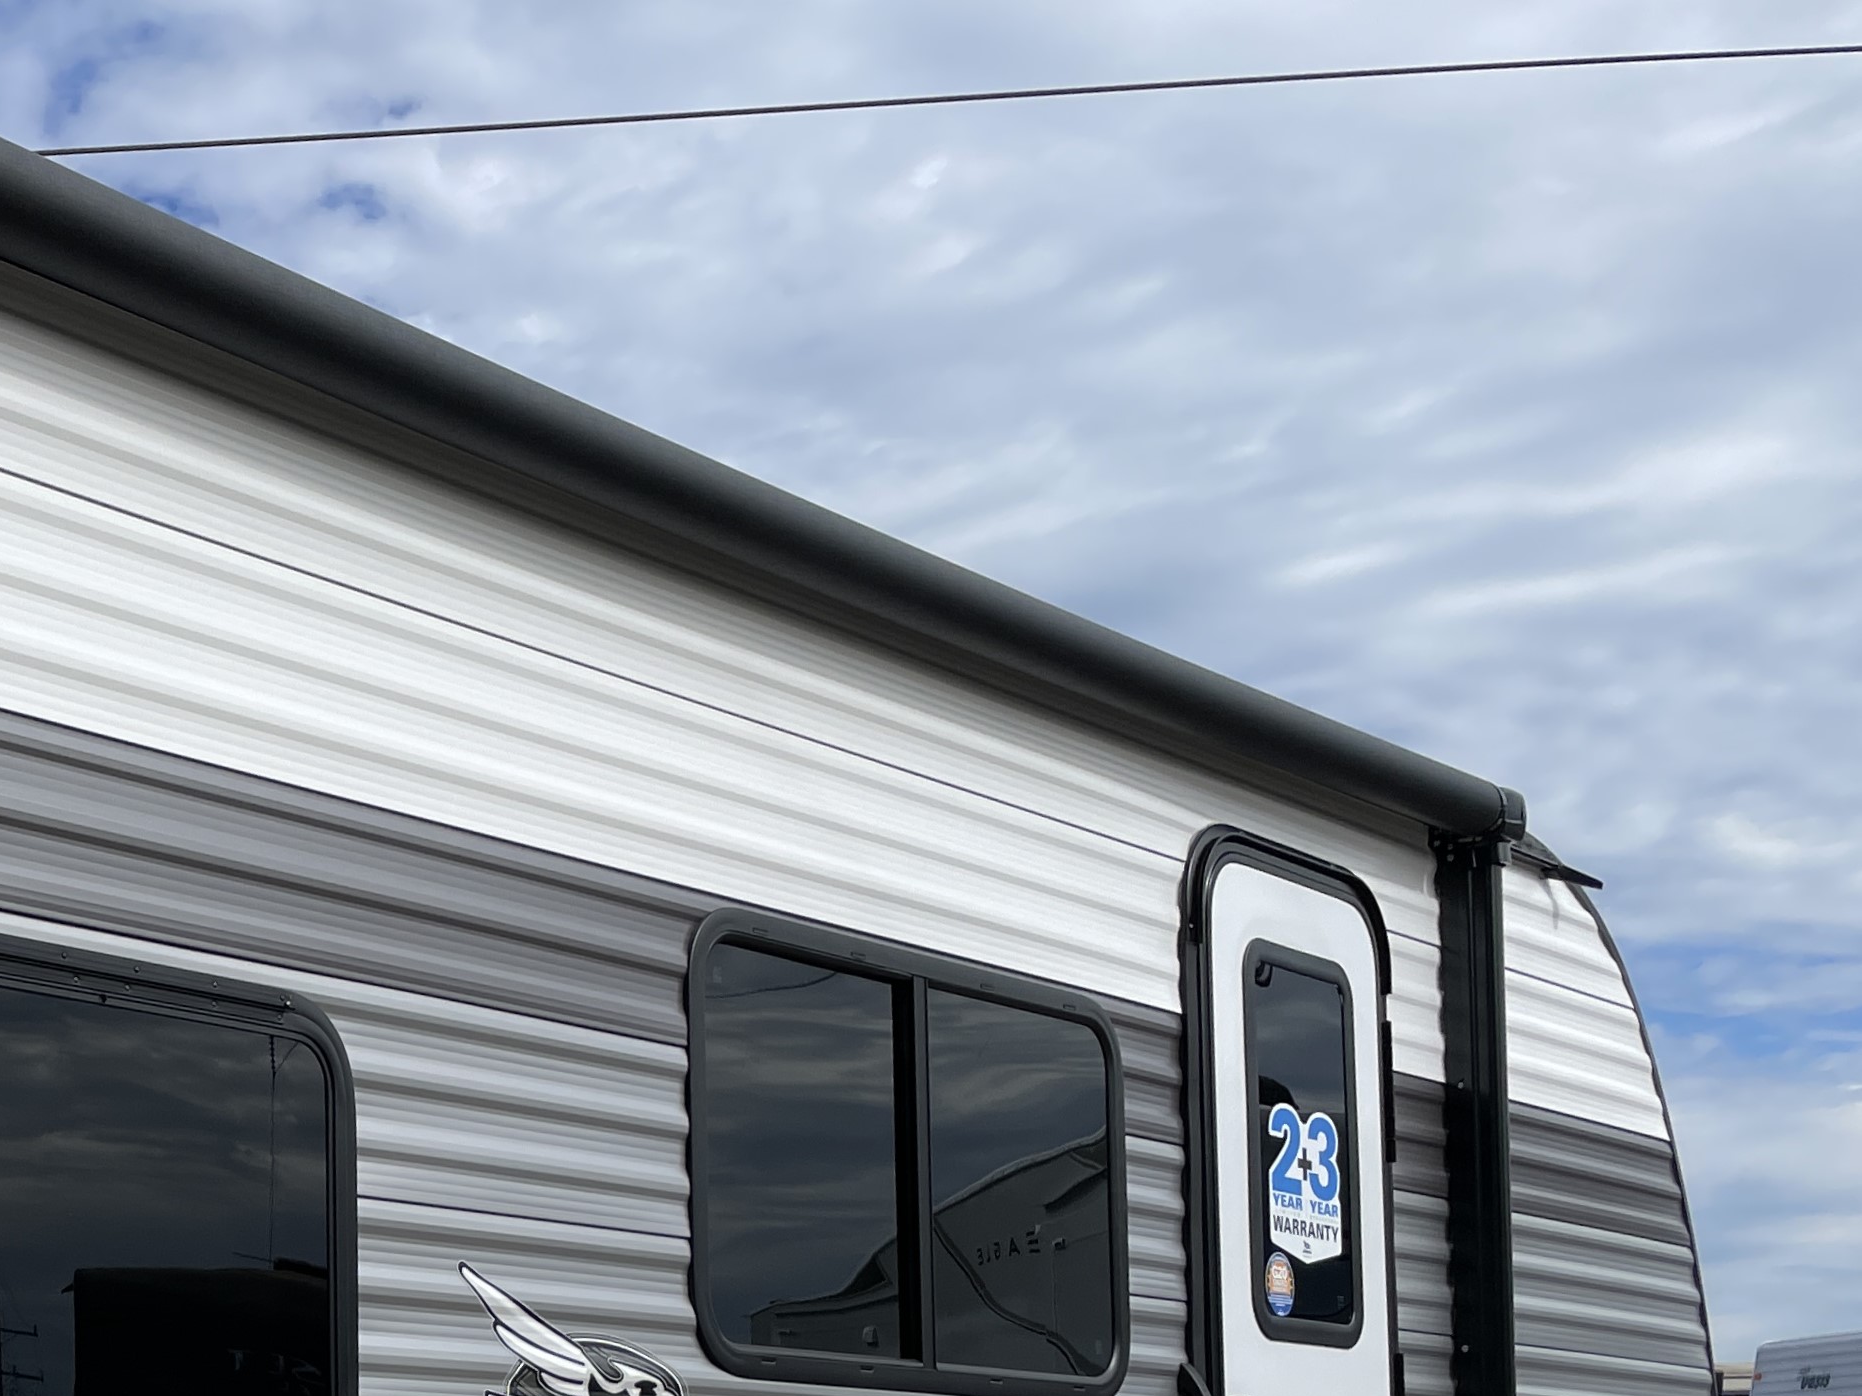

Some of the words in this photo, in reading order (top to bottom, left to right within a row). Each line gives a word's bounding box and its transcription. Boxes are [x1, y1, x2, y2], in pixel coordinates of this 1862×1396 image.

[1272, 1192, 1303, 1212] YEAR
[1309, 1199, 1339, 1218] YEAR
[1272, 1214, 1340, 1244] WARRANTY
